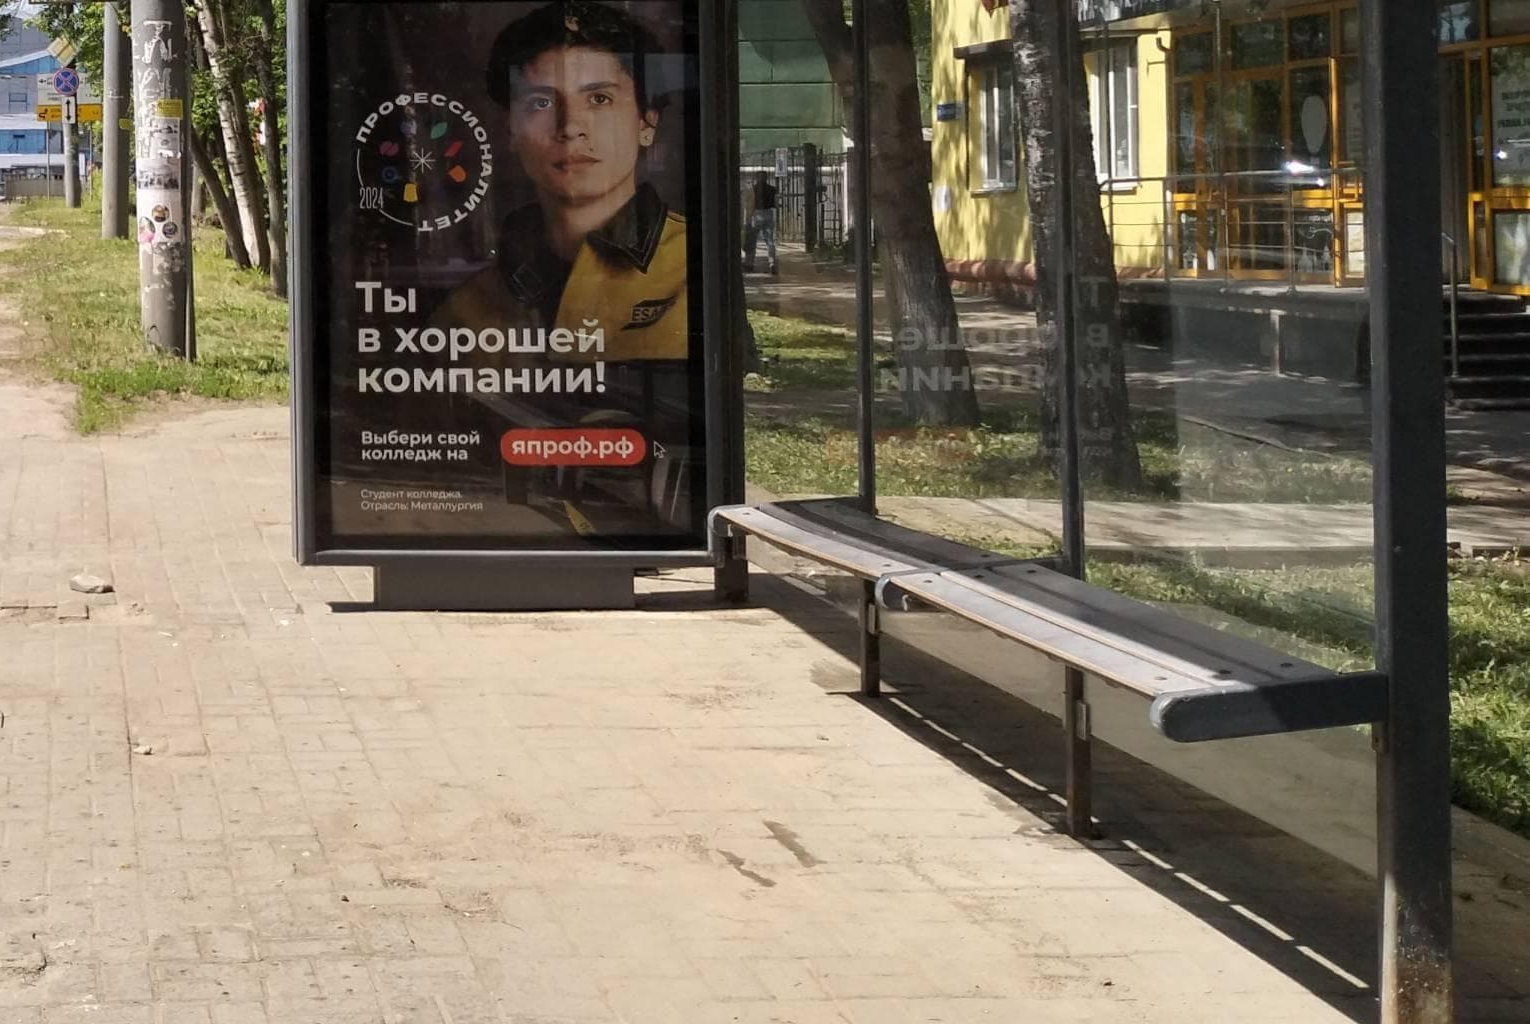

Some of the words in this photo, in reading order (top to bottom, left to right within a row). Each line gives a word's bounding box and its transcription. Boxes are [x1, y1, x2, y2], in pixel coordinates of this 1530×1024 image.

[356, 92, 493, 232] ПРОФЕССИОНАЛИТЕТ
[359, 187, 385, 209] 2024
[355, 281, 417, 313] Ты
[358, 328, 381, 353] в
[394, 318, 605, 361] хорошей
[358, 361, 606, 393] компании!
[361, 429, 433, 448] Выбери
[437, 429, 481, 446] свой
[511, 435, 634, 459] япроф.рф
[361, 448, 442, 462] колледж
[446, 449, 469, 461] на
[360, 488, 404, 501] Студент
[360, 500, 409, 512] Отрасль:
[411, 500, 484, 512] Металлургия
